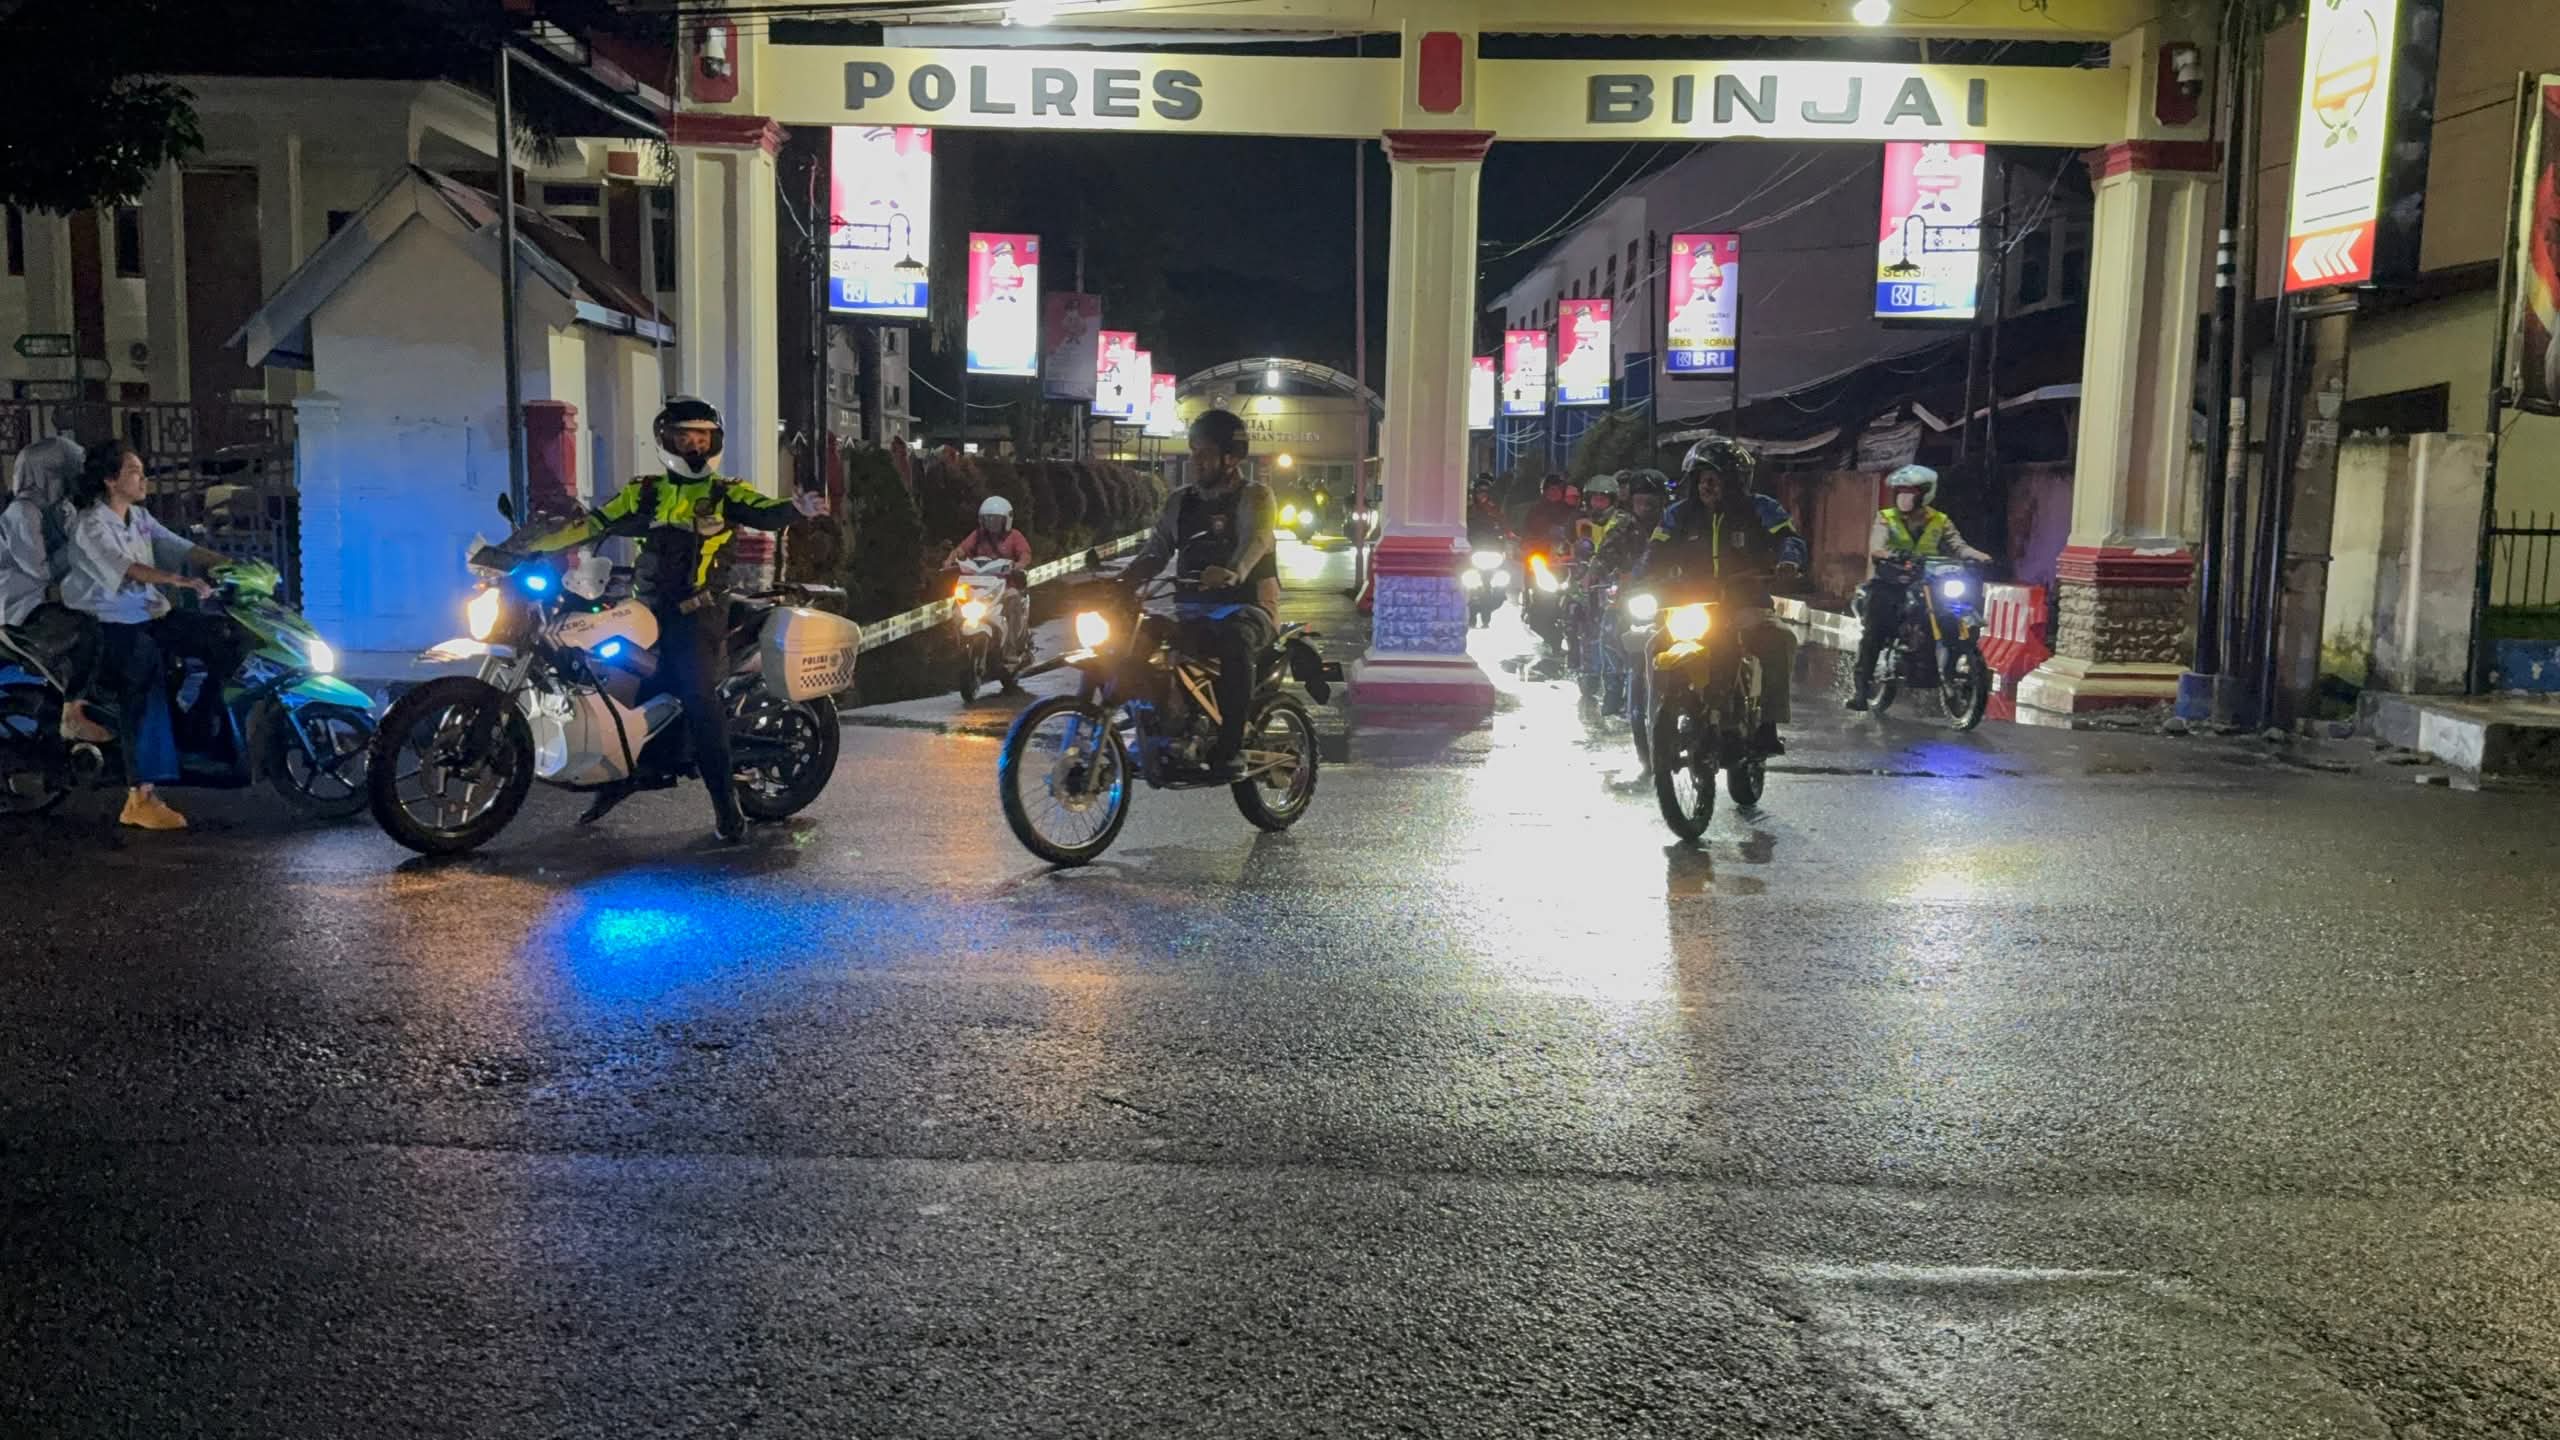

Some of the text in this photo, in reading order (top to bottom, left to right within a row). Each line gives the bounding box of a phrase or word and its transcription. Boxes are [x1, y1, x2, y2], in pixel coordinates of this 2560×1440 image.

[844, 61, 1987, 127] POLRES BINJAI
[1693, 351, 1726, 366] BRI
